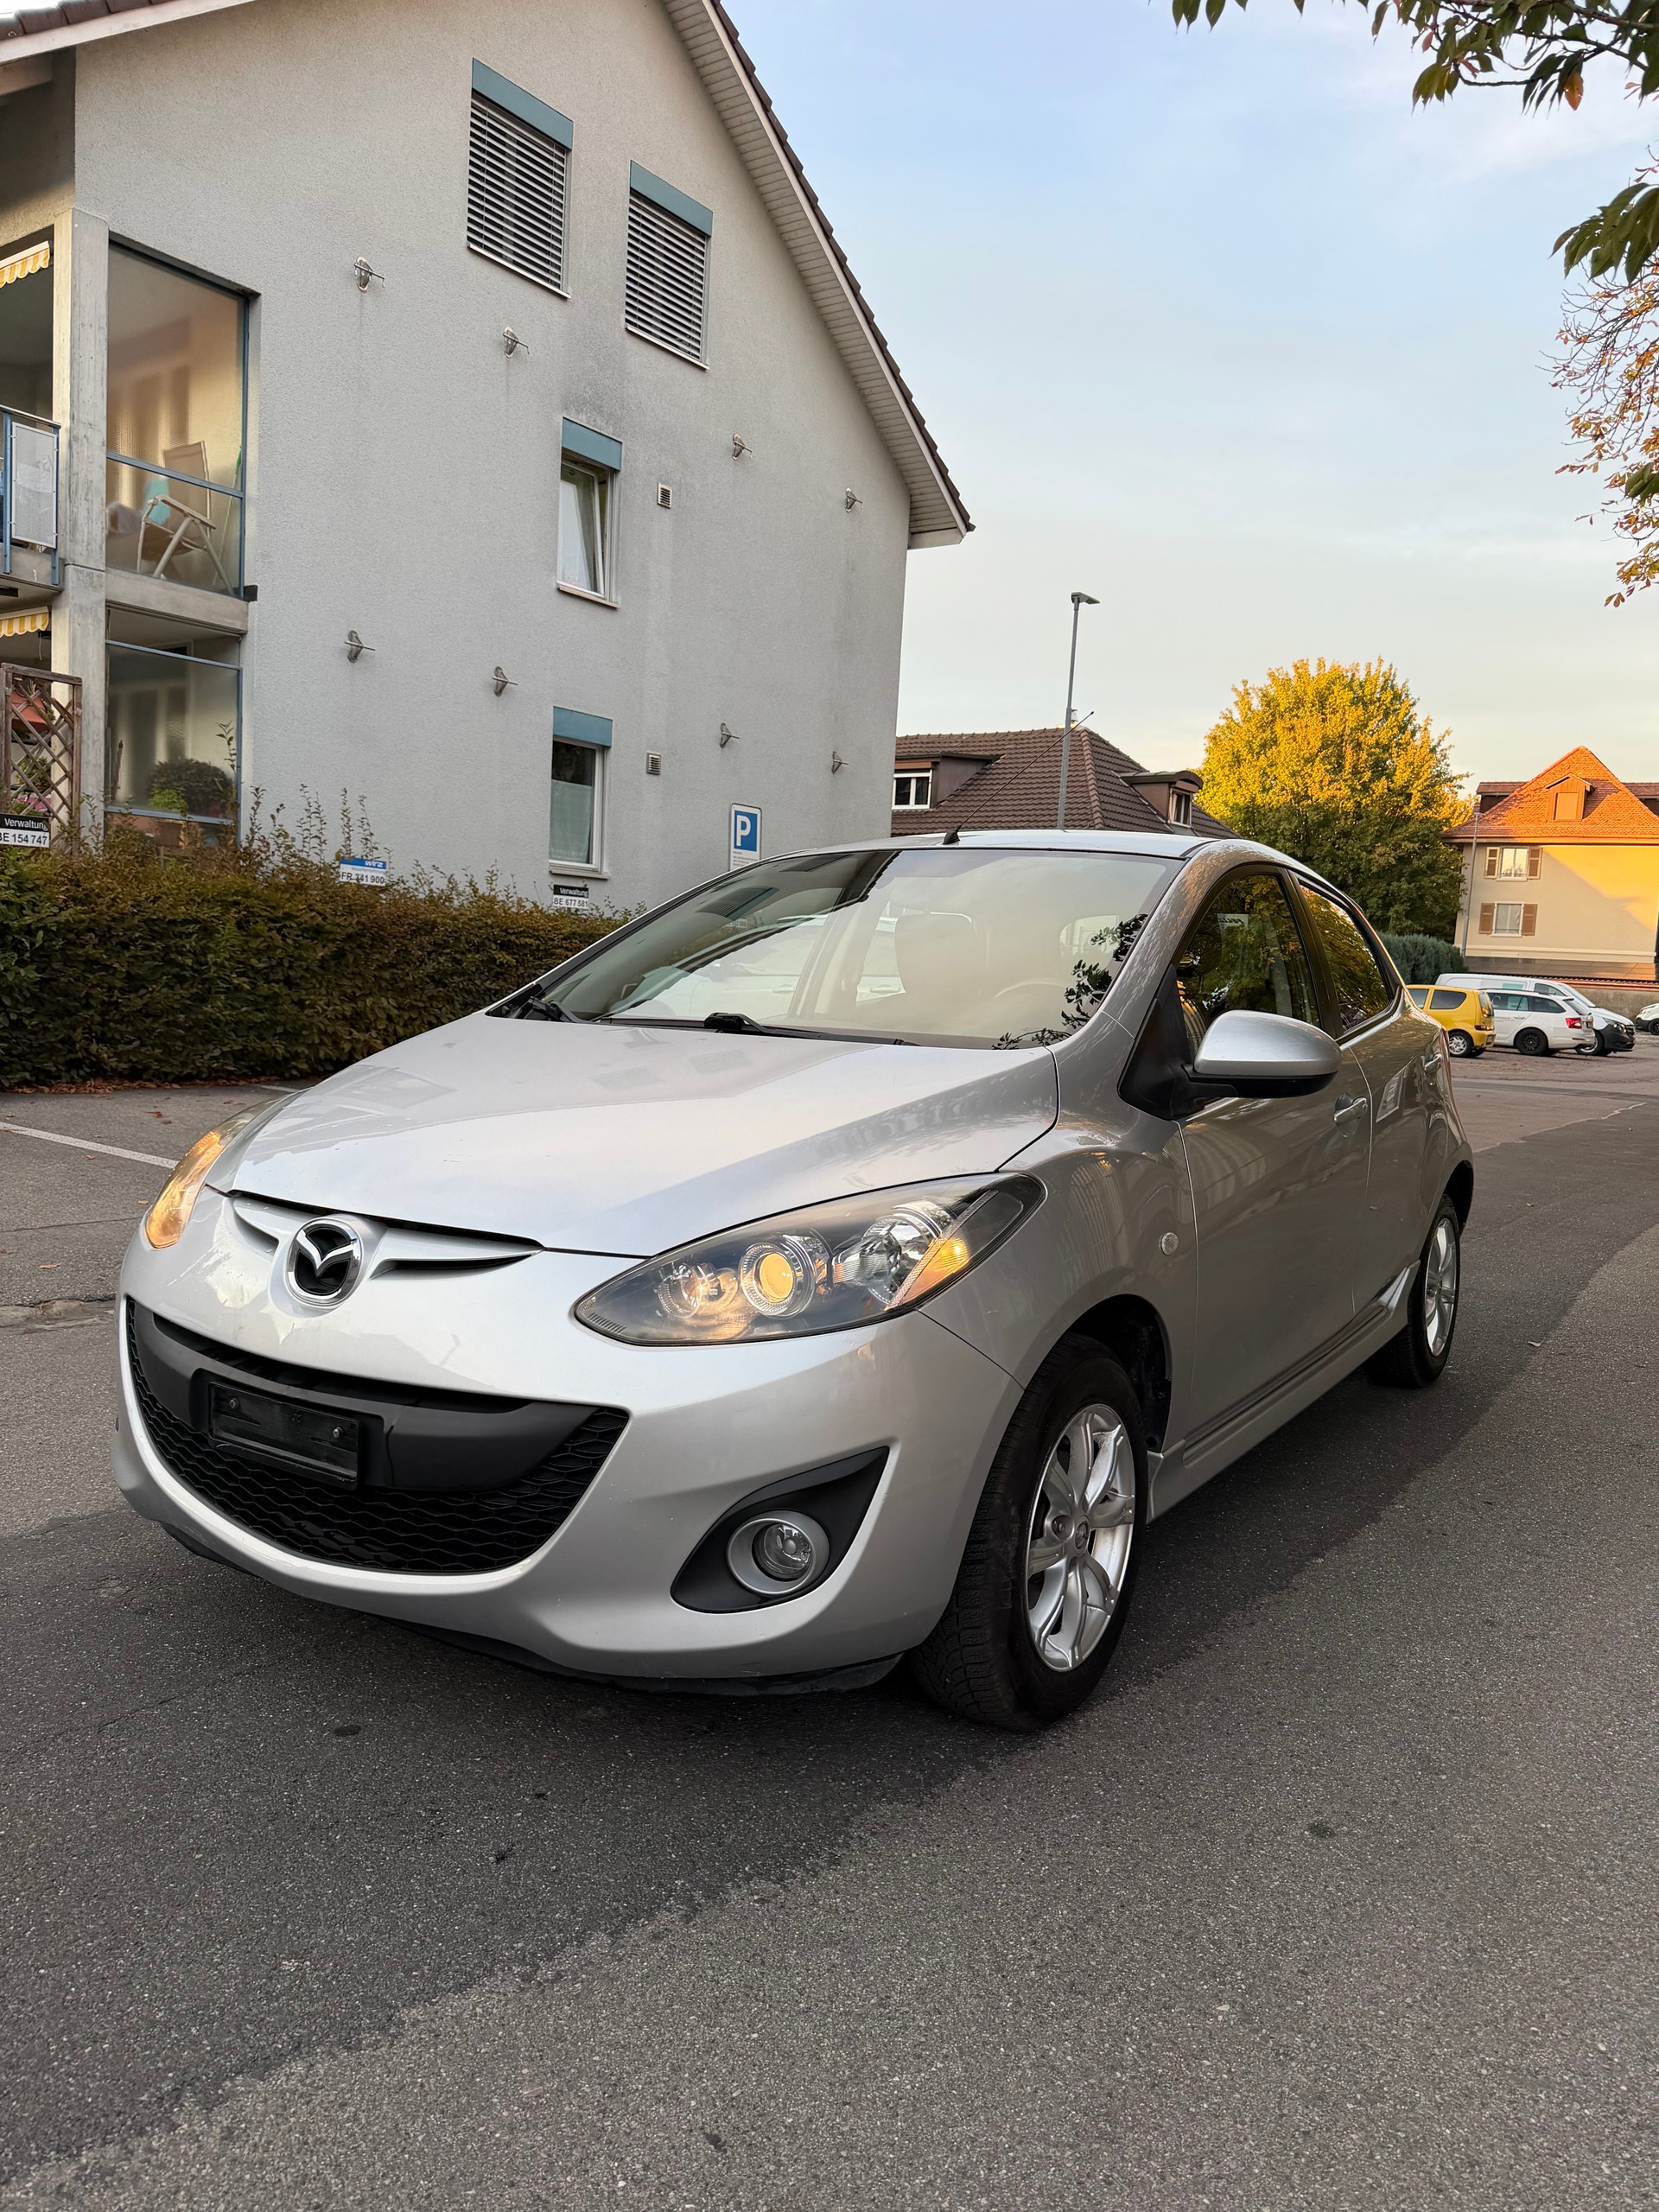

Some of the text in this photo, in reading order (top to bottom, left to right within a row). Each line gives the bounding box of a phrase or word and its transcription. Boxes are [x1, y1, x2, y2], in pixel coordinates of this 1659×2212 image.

[4, 817, 48, 831] Verwaltung
[736, 815, 752, 847] P
[12, 833, 29, 843] 154
[30, 835, 48, 845] 747
[341, 872, 353, 880] FR
[370, 875, 385, 885] 900
